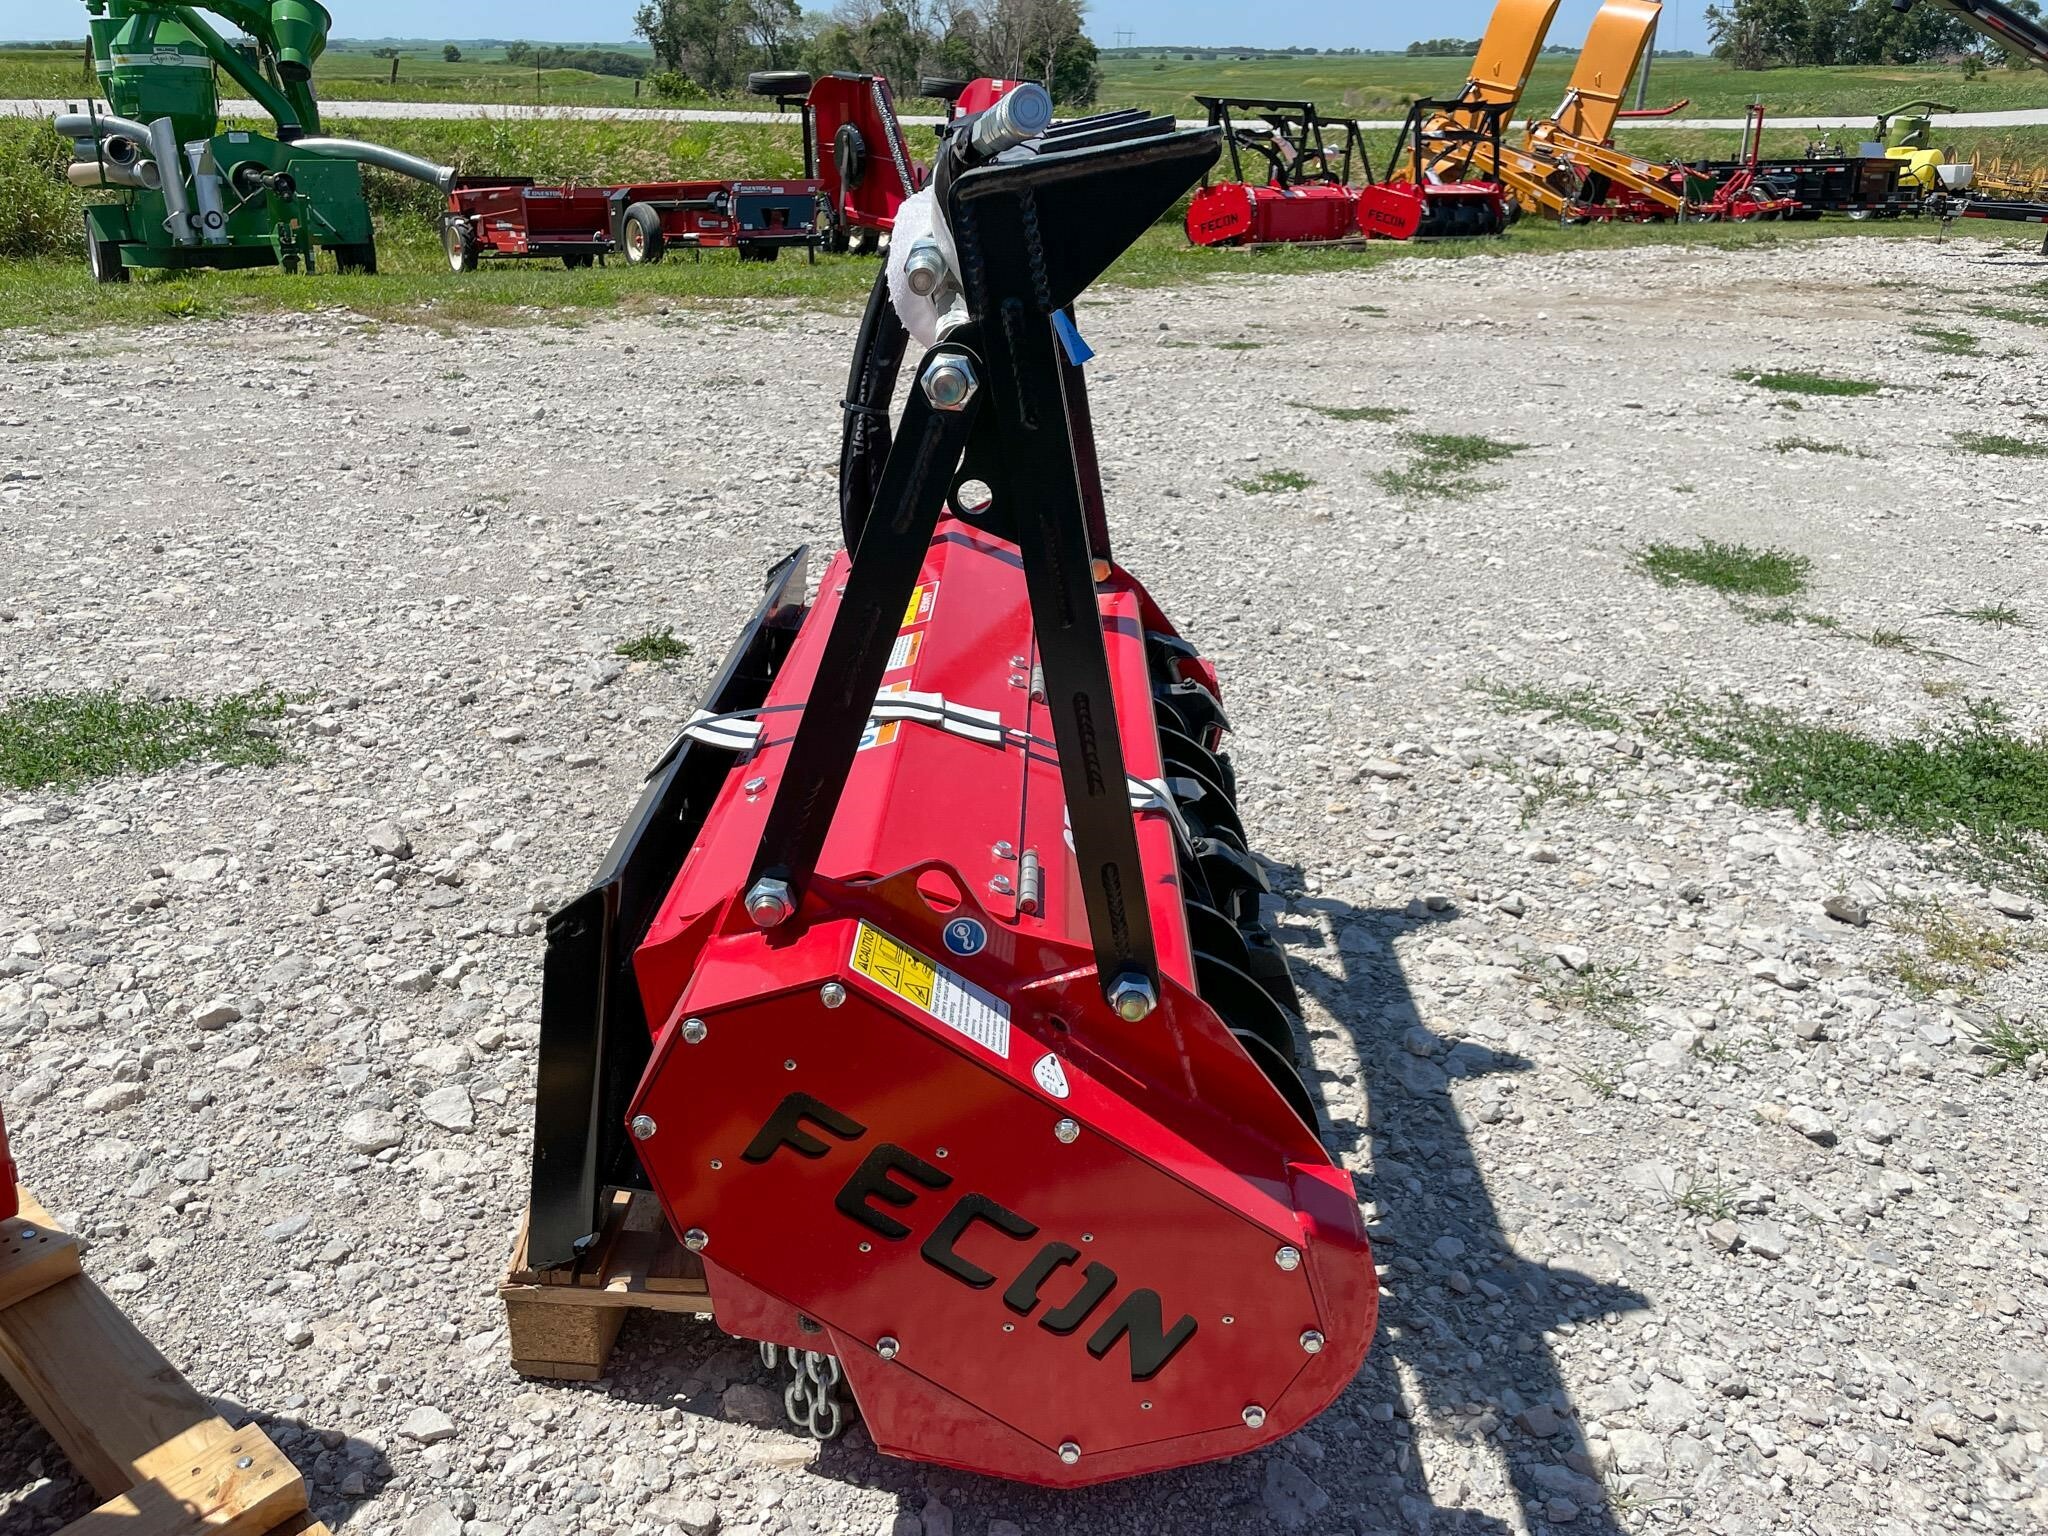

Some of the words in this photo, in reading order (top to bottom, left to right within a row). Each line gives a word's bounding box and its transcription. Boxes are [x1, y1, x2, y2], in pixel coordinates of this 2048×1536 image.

[1200, 213, 1239, 234] FECON
[1368, 209, 1406, 228] FECON
[859, 928, 875, 961] CAUTION
[739, 1091, 1198, 1382] FECON
